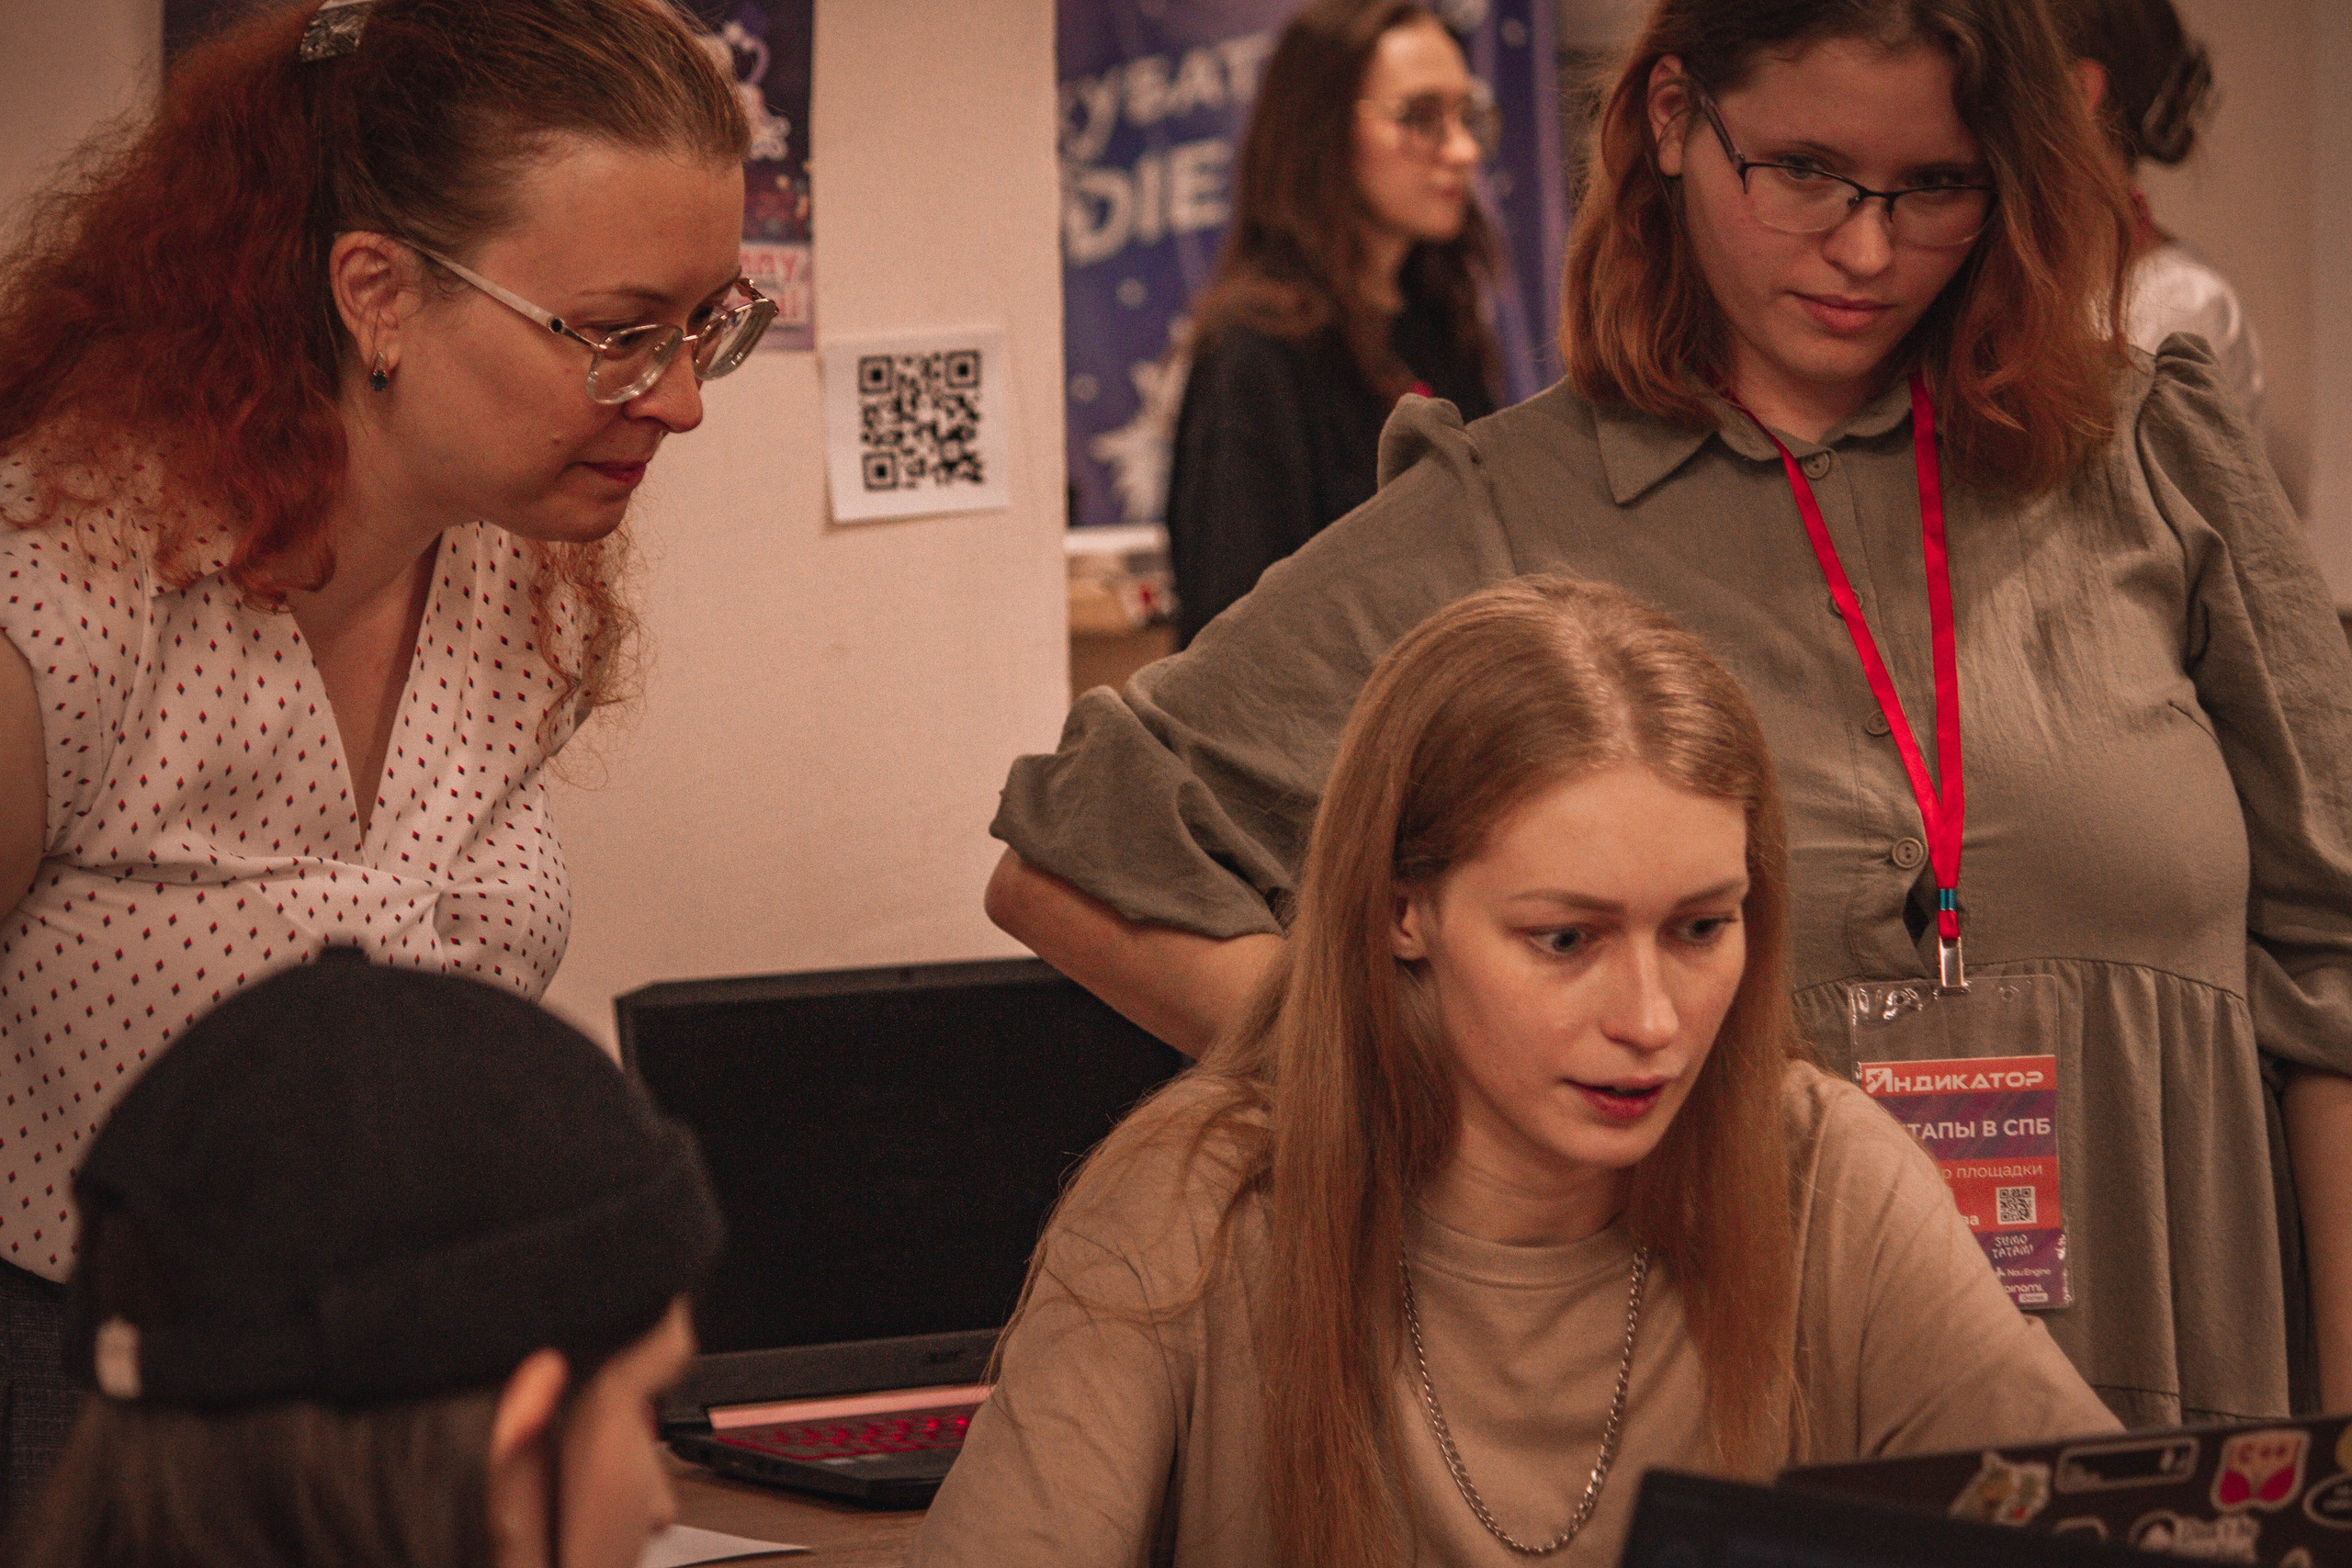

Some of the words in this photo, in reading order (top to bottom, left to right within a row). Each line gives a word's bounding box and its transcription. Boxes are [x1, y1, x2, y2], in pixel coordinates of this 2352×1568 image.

[1064, 138, 1236, 265] DIE
[1904, 1121, 1975, 1140] ТАПЫ
[1983, 1120, 1997, 1138] В
[2003, 1117, 2052, 1137] СПБ
[1956, 1164, 2043, 1179] площадки
[1991, 1244, 2035, 1259] TATAMI
